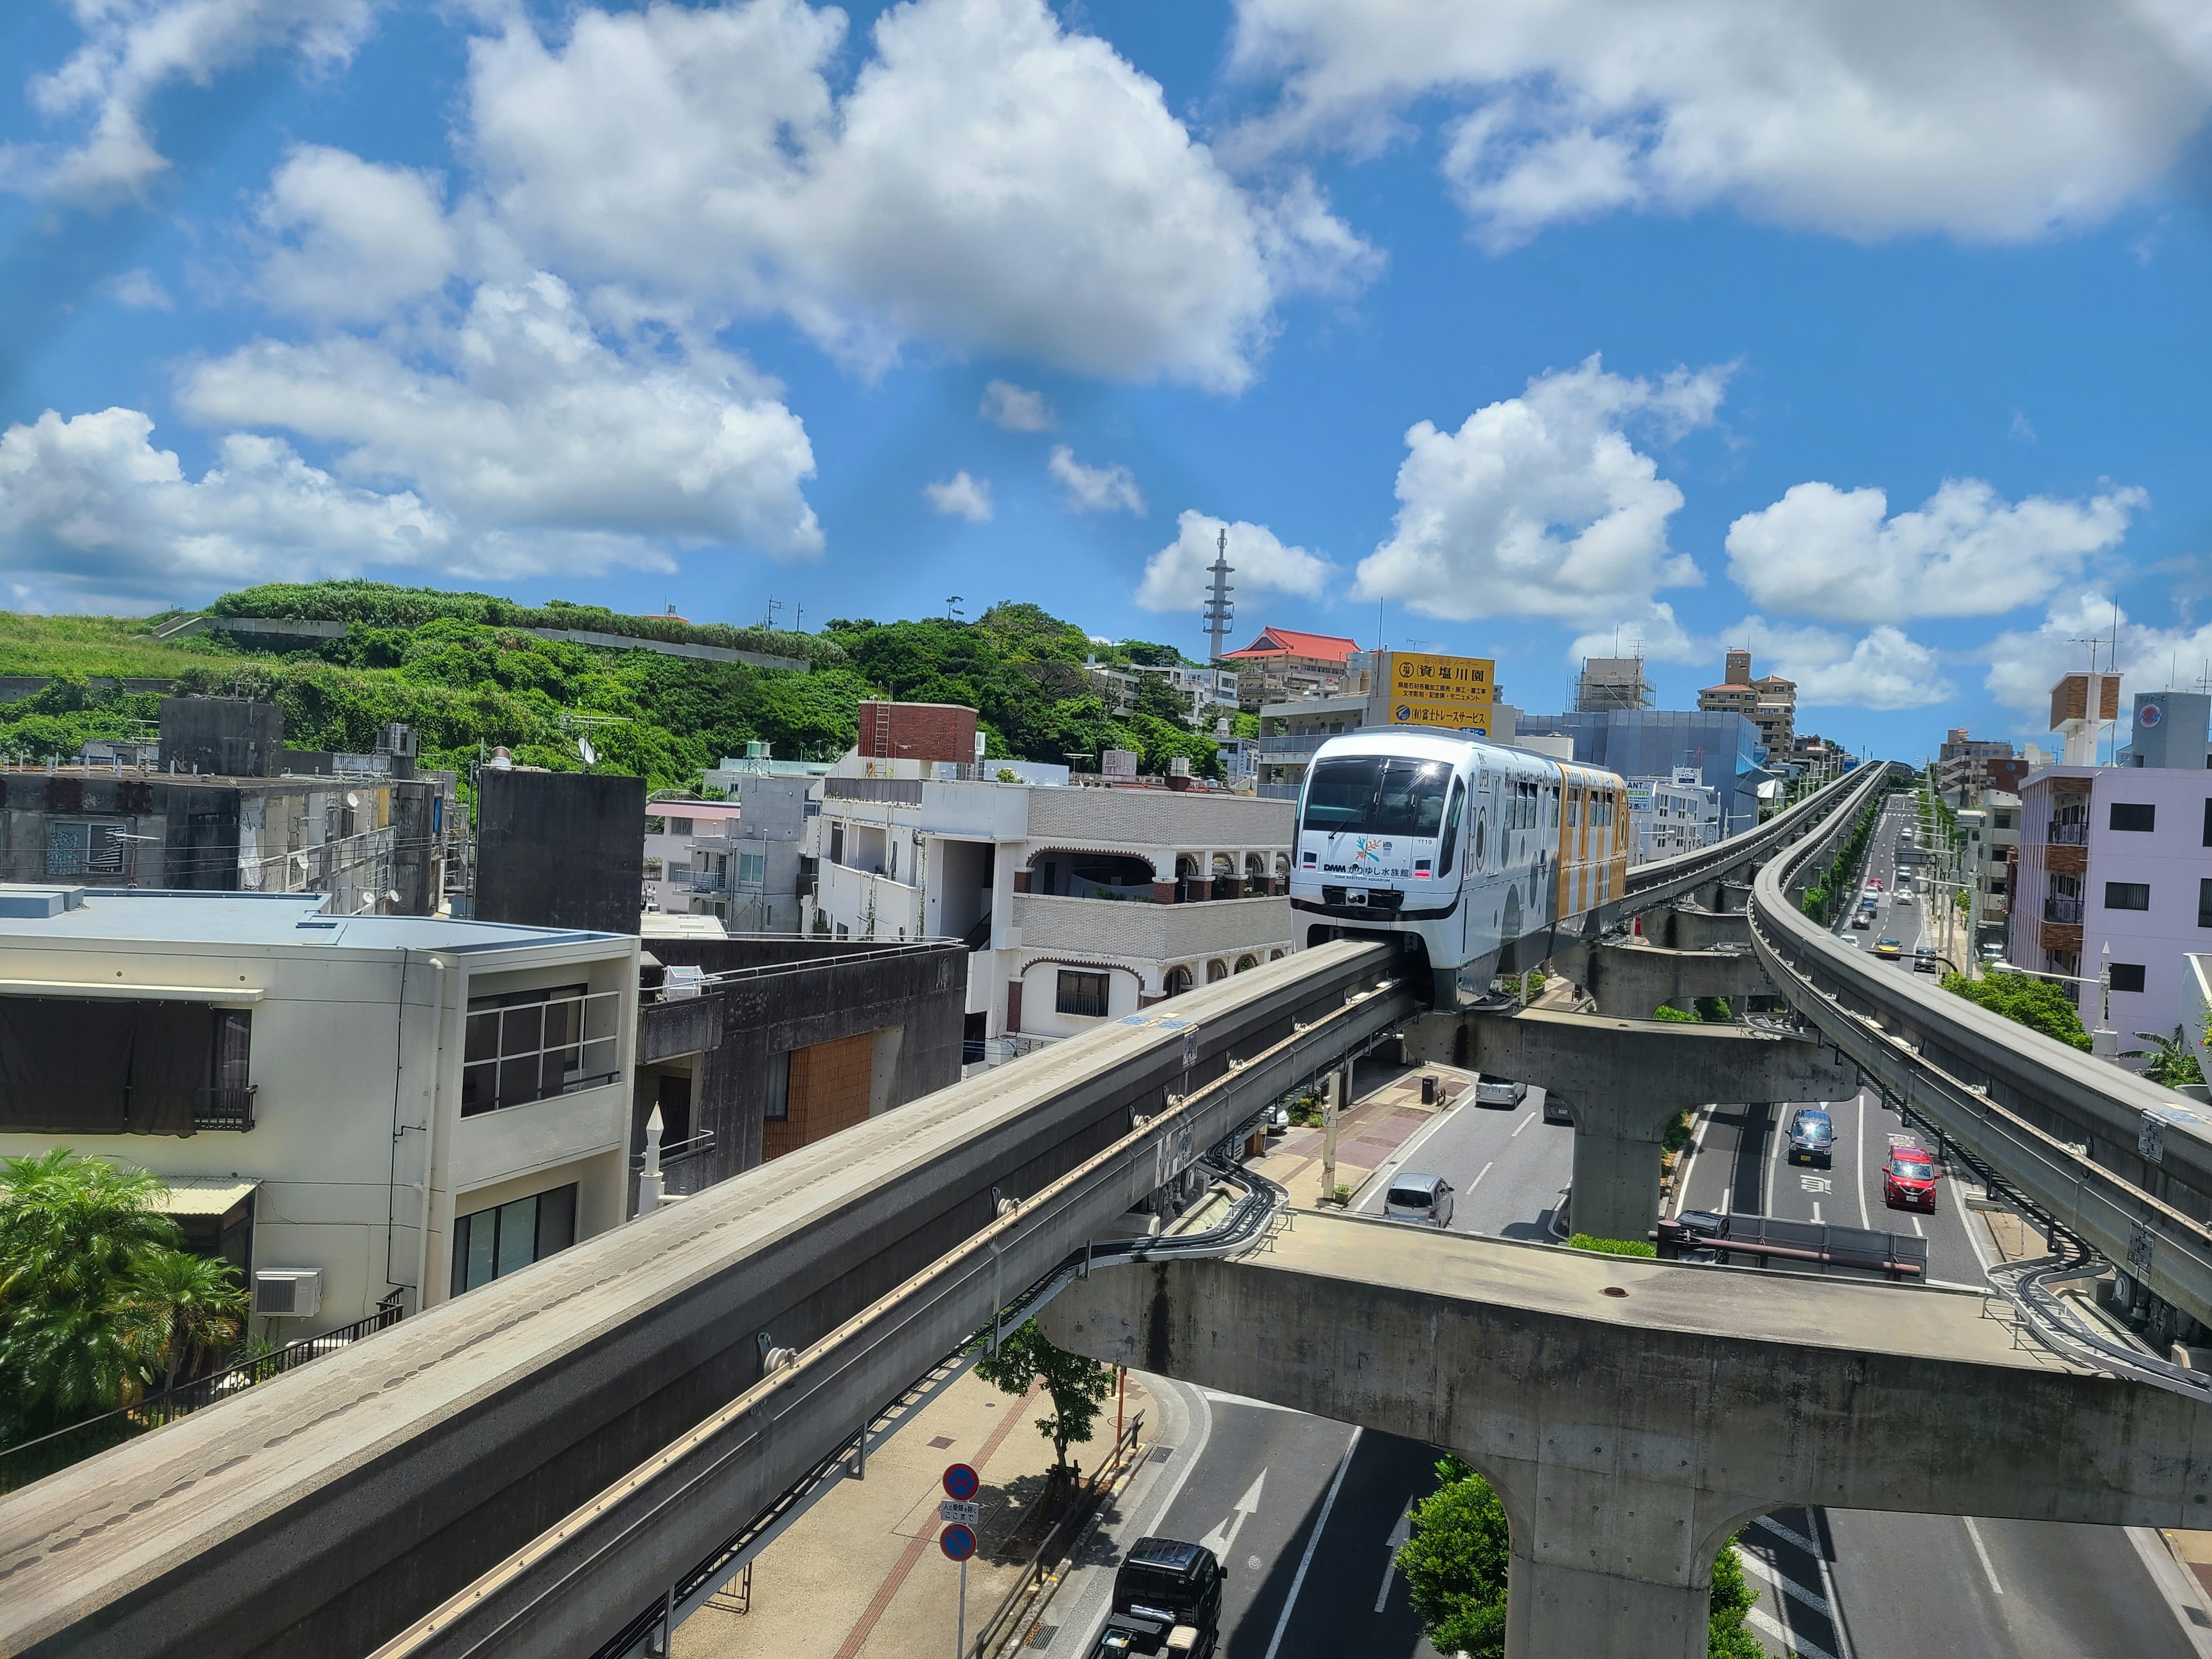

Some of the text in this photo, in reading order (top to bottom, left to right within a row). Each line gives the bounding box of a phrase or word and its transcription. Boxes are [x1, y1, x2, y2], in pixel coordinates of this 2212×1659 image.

[1411, 708, 1485, 724] (有)富士トレースサービス
[1479, 768, 1490, 787] OPEN
[1324, 863, 1410, 878] DMM かりゆし水族館
[943, 1502, 977, 1514] 人の乗降を除く
[945, 1512, 974, 1521] ここまで
